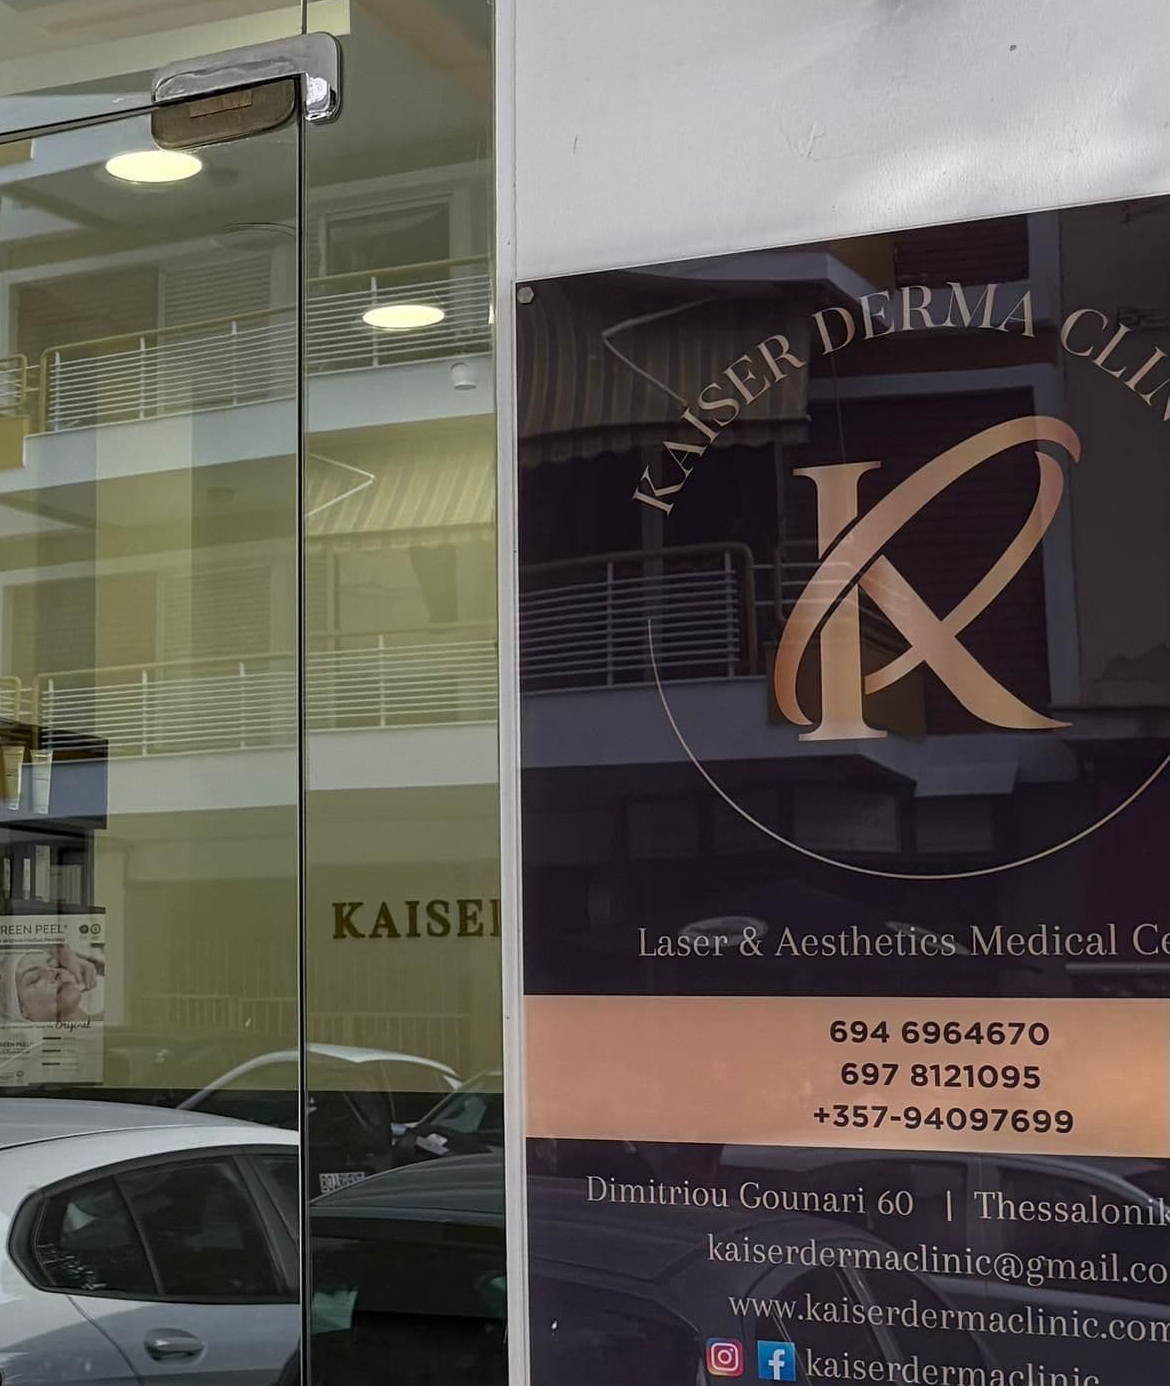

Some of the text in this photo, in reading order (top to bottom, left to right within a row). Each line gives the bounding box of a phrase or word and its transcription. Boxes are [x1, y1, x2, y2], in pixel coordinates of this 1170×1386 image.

[632, 332, 806, 516] KAISER
[811, 281, 1036, 355] DERMA
[637, 928, 728, 958] Laser
[739, 927, 764, 956] &
[776, 925, 956, 957] Aesthetics
[970, 924, 1117, 956] Medical
[830, 1021, 1049, 1046] 694 6964670
[840, 1063, 1041, 1089] 697 8121095
[814, 1105, 1074, 1134] +357-94097699
[586, 1175, 729, 1208] Dimitriou
[739, 1182, 866, 1214] Gounari
[877, 1191, 914, 1216] 60
[708, 1234, 1168, 1286] kaiserdermaclinic@gmail.co
[729, 1294, 1170, 1344] www.kaiserdermaclinic.com
